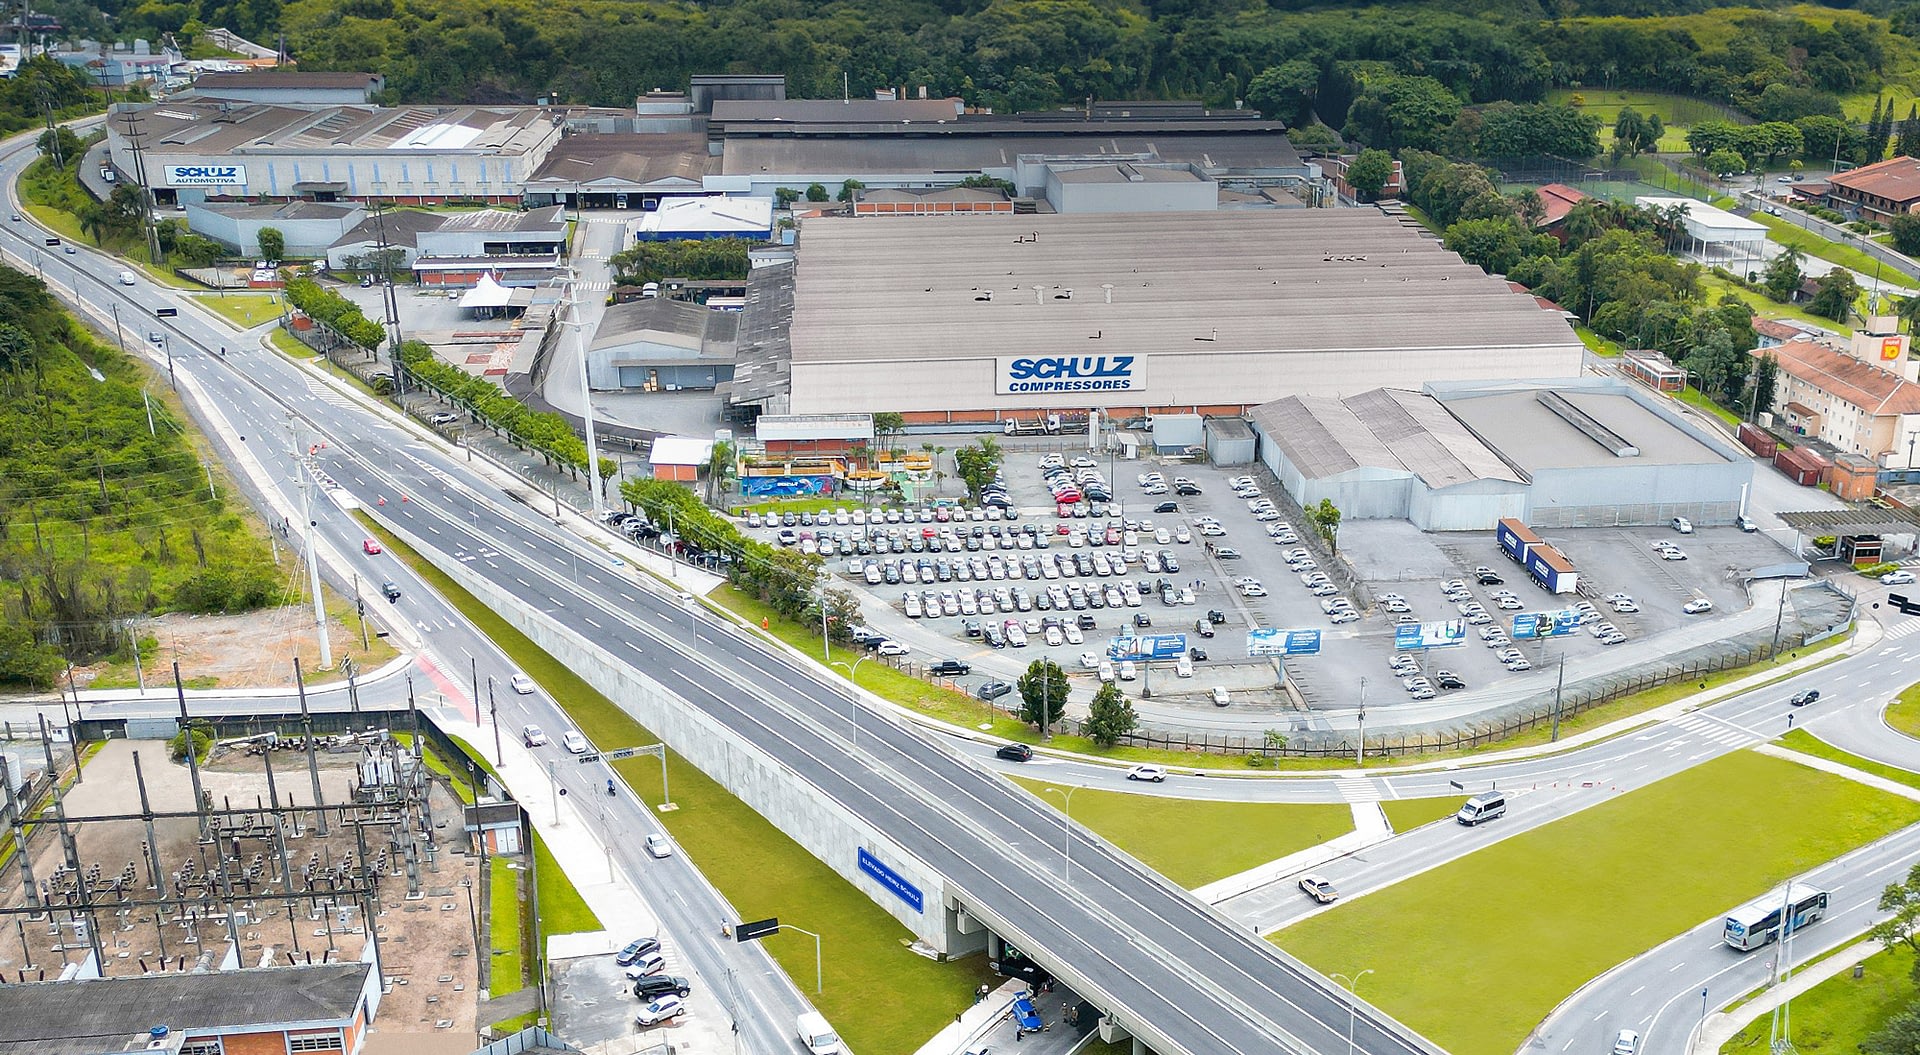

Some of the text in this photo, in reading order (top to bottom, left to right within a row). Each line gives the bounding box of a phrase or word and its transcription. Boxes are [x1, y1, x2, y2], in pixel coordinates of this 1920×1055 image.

[175, 167, 236, 177] SCHULZ
[1009, 356, 1134, 379] SCHULZ
[1009, 380, 1131, 392] COMPRESSORES
[862, 857, 920, 903] ELEVADO HEINZ SCHULZ
